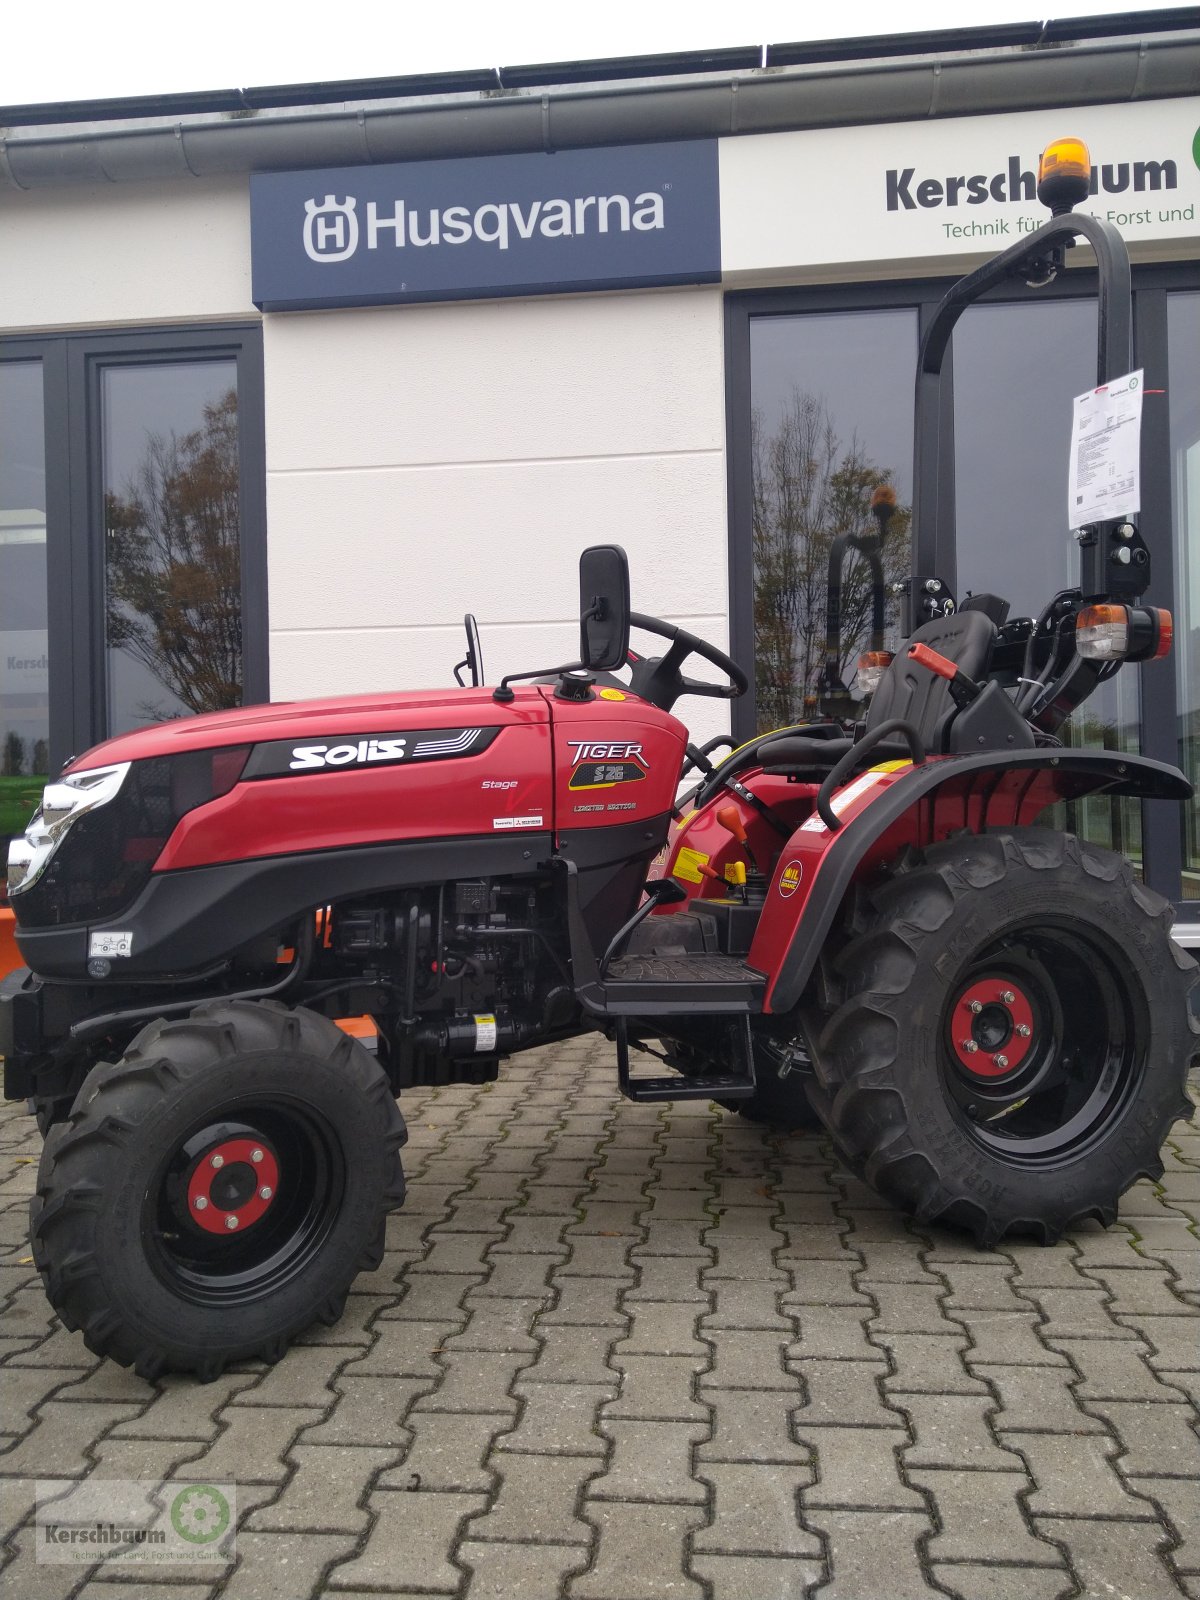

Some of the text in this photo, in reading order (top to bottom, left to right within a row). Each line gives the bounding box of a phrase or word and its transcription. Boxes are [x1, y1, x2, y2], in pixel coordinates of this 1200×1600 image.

[367, 191, 666, 249] Husqvarna
[942, 217, 1010, 239] Technik
[1106, 208, 1153, 227] Forst
[1159, 204, 1195, 223] und
[567, 741, 650, 768] TIGER
[481, 780, 519, 790] Stage
